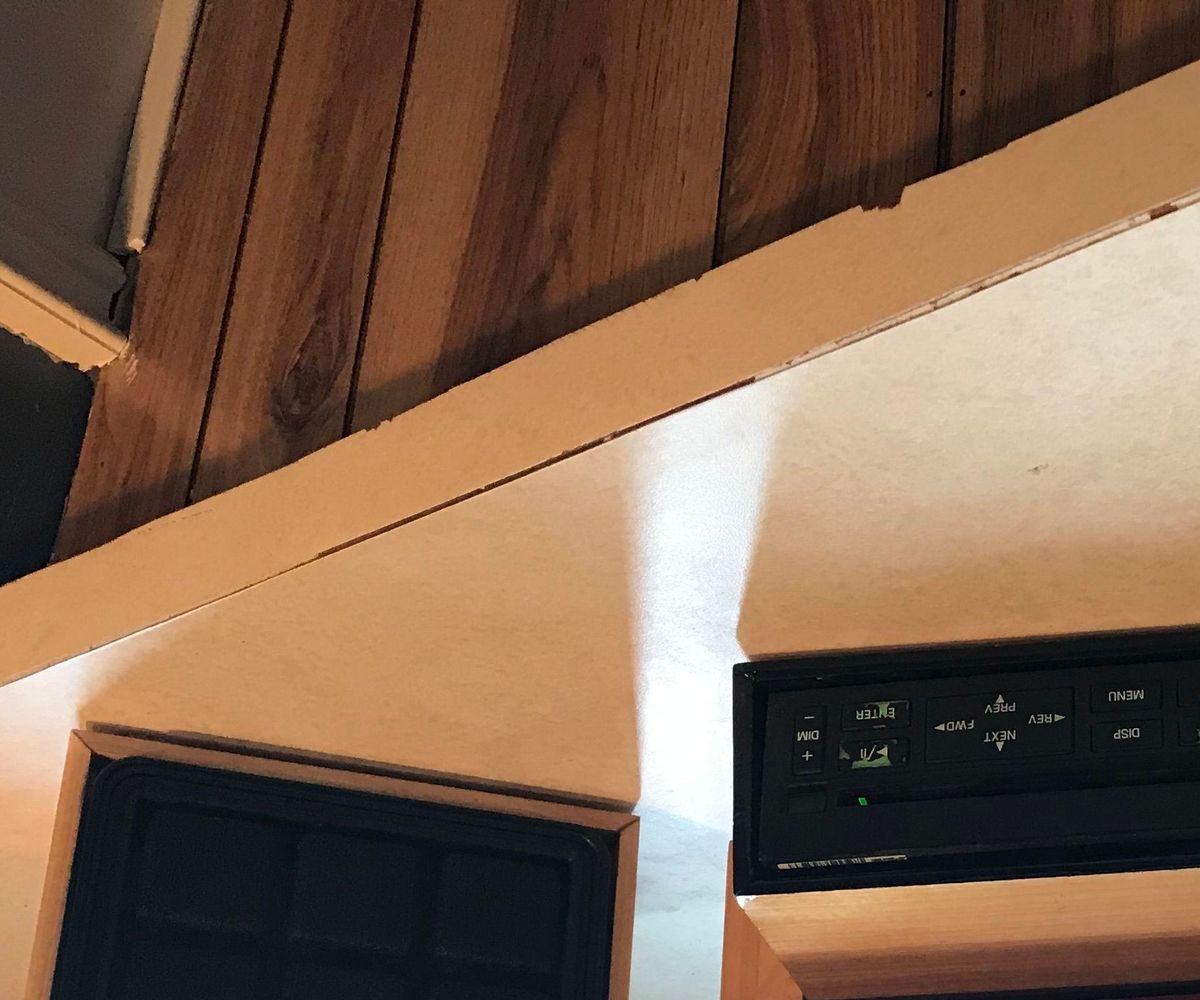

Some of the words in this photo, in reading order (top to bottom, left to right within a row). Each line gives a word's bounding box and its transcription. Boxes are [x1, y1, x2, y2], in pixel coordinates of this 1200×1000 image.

[1108, 689, 1145, 702] MENU
[984, 701, 1016, 714] PREV
[945, 719, 975, 731] FWD
[1028, 713, 1053, 725] REV
[796, 730, 820, 742] DIM
[983, 730, 1016, 742] NEXT
[1113, 727, 1140, 740] DISP
